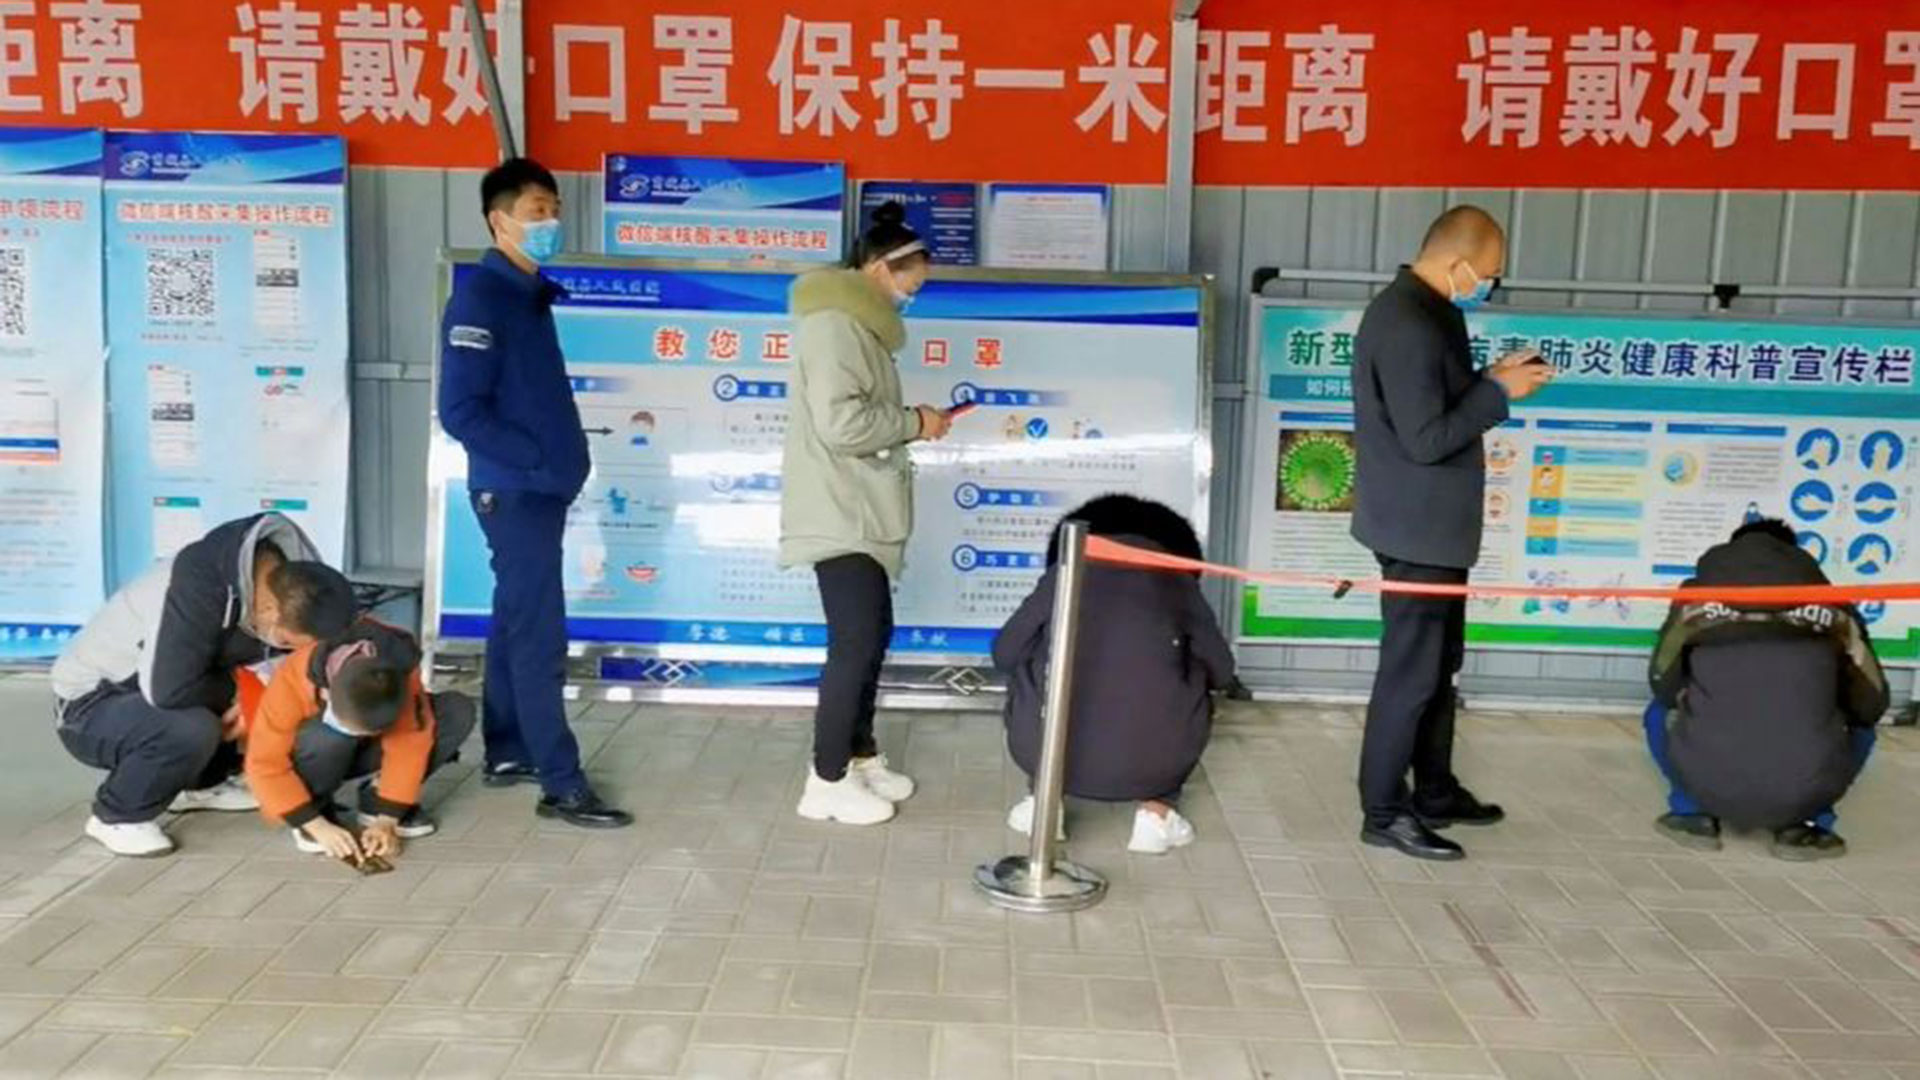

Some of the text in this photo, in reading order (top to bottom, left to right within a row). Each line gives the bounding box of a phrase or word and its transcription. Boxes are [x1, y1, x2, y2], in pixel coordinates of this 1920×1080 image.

[1458, 27, 1920, 149] 请戴好口罩
[656, 329, 1002, 367] 教您正 口罩
